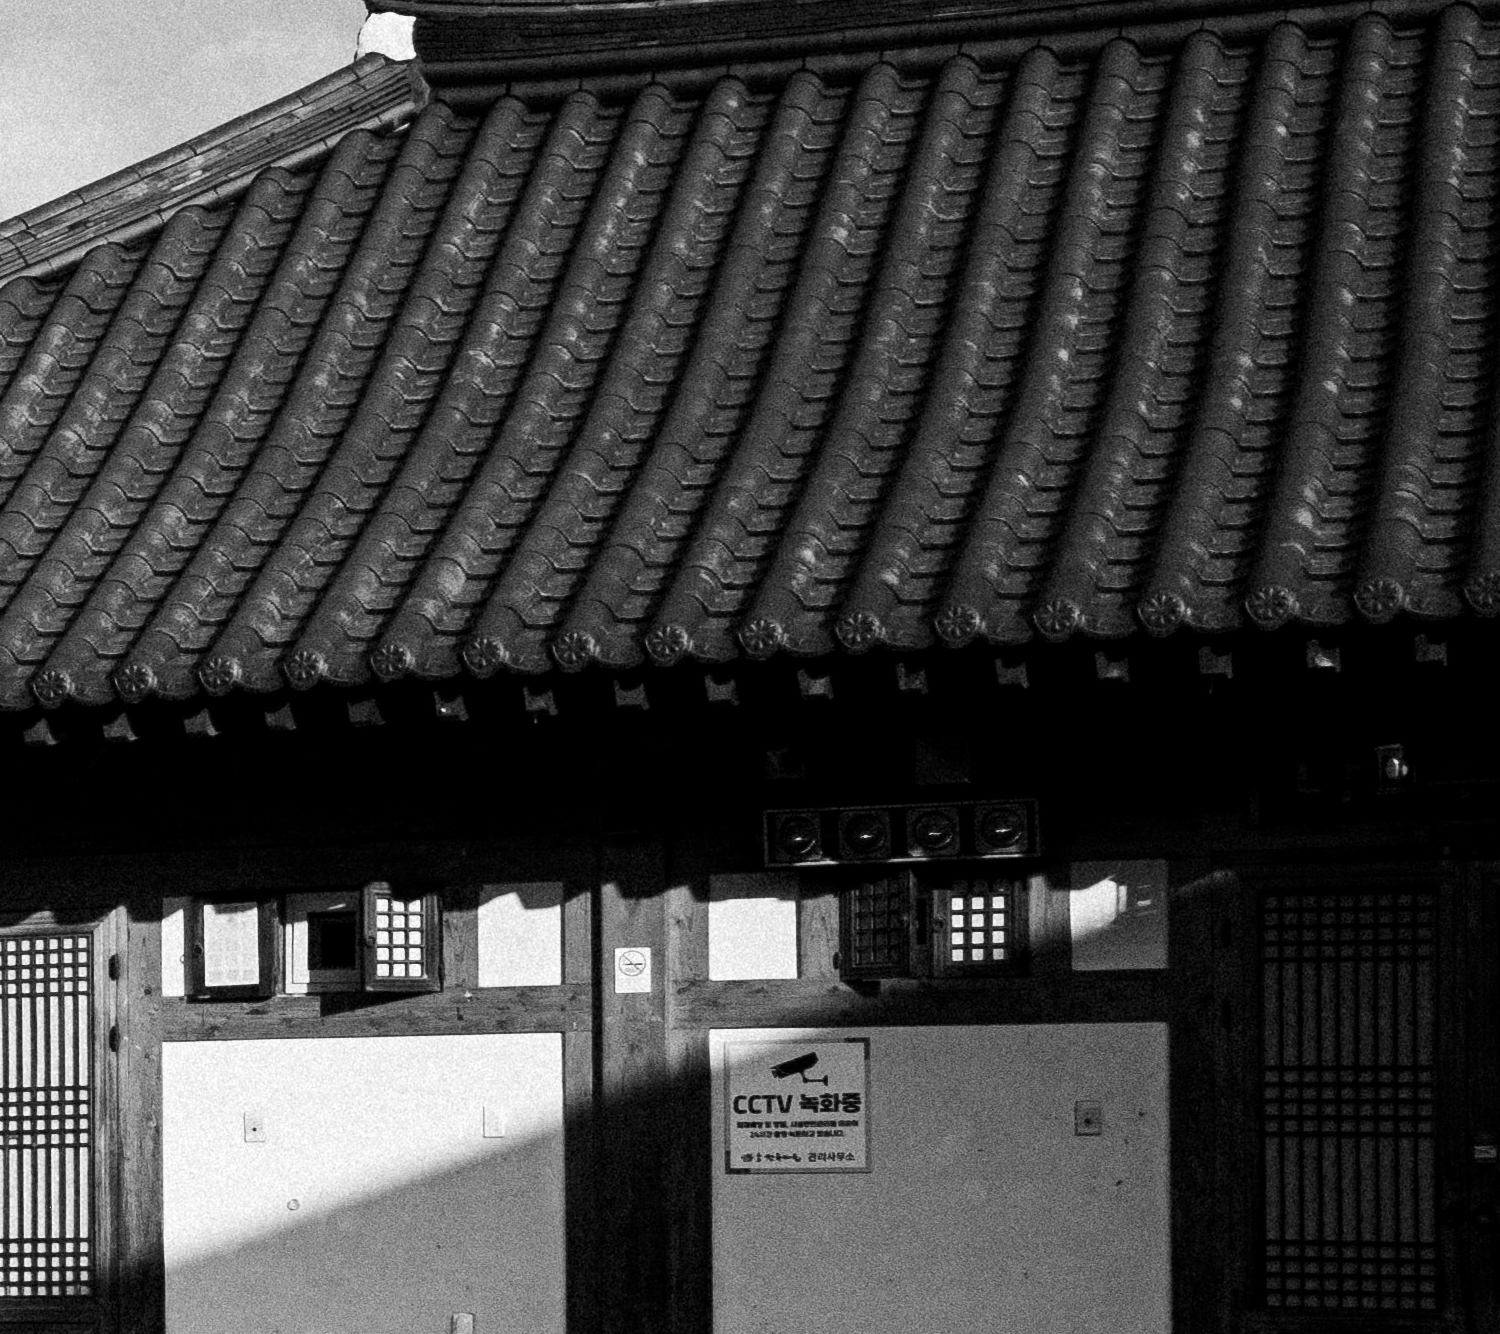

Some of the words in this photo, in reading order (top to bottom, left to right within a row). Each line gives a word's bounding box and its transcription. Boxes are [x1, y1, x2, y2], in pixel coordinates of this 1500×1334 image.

[733, 1094, 793, 1114] CCTV
[799, 1092, 862, 1113] 녹화중
[807, 1152, 856, 1162] 관리사무소
